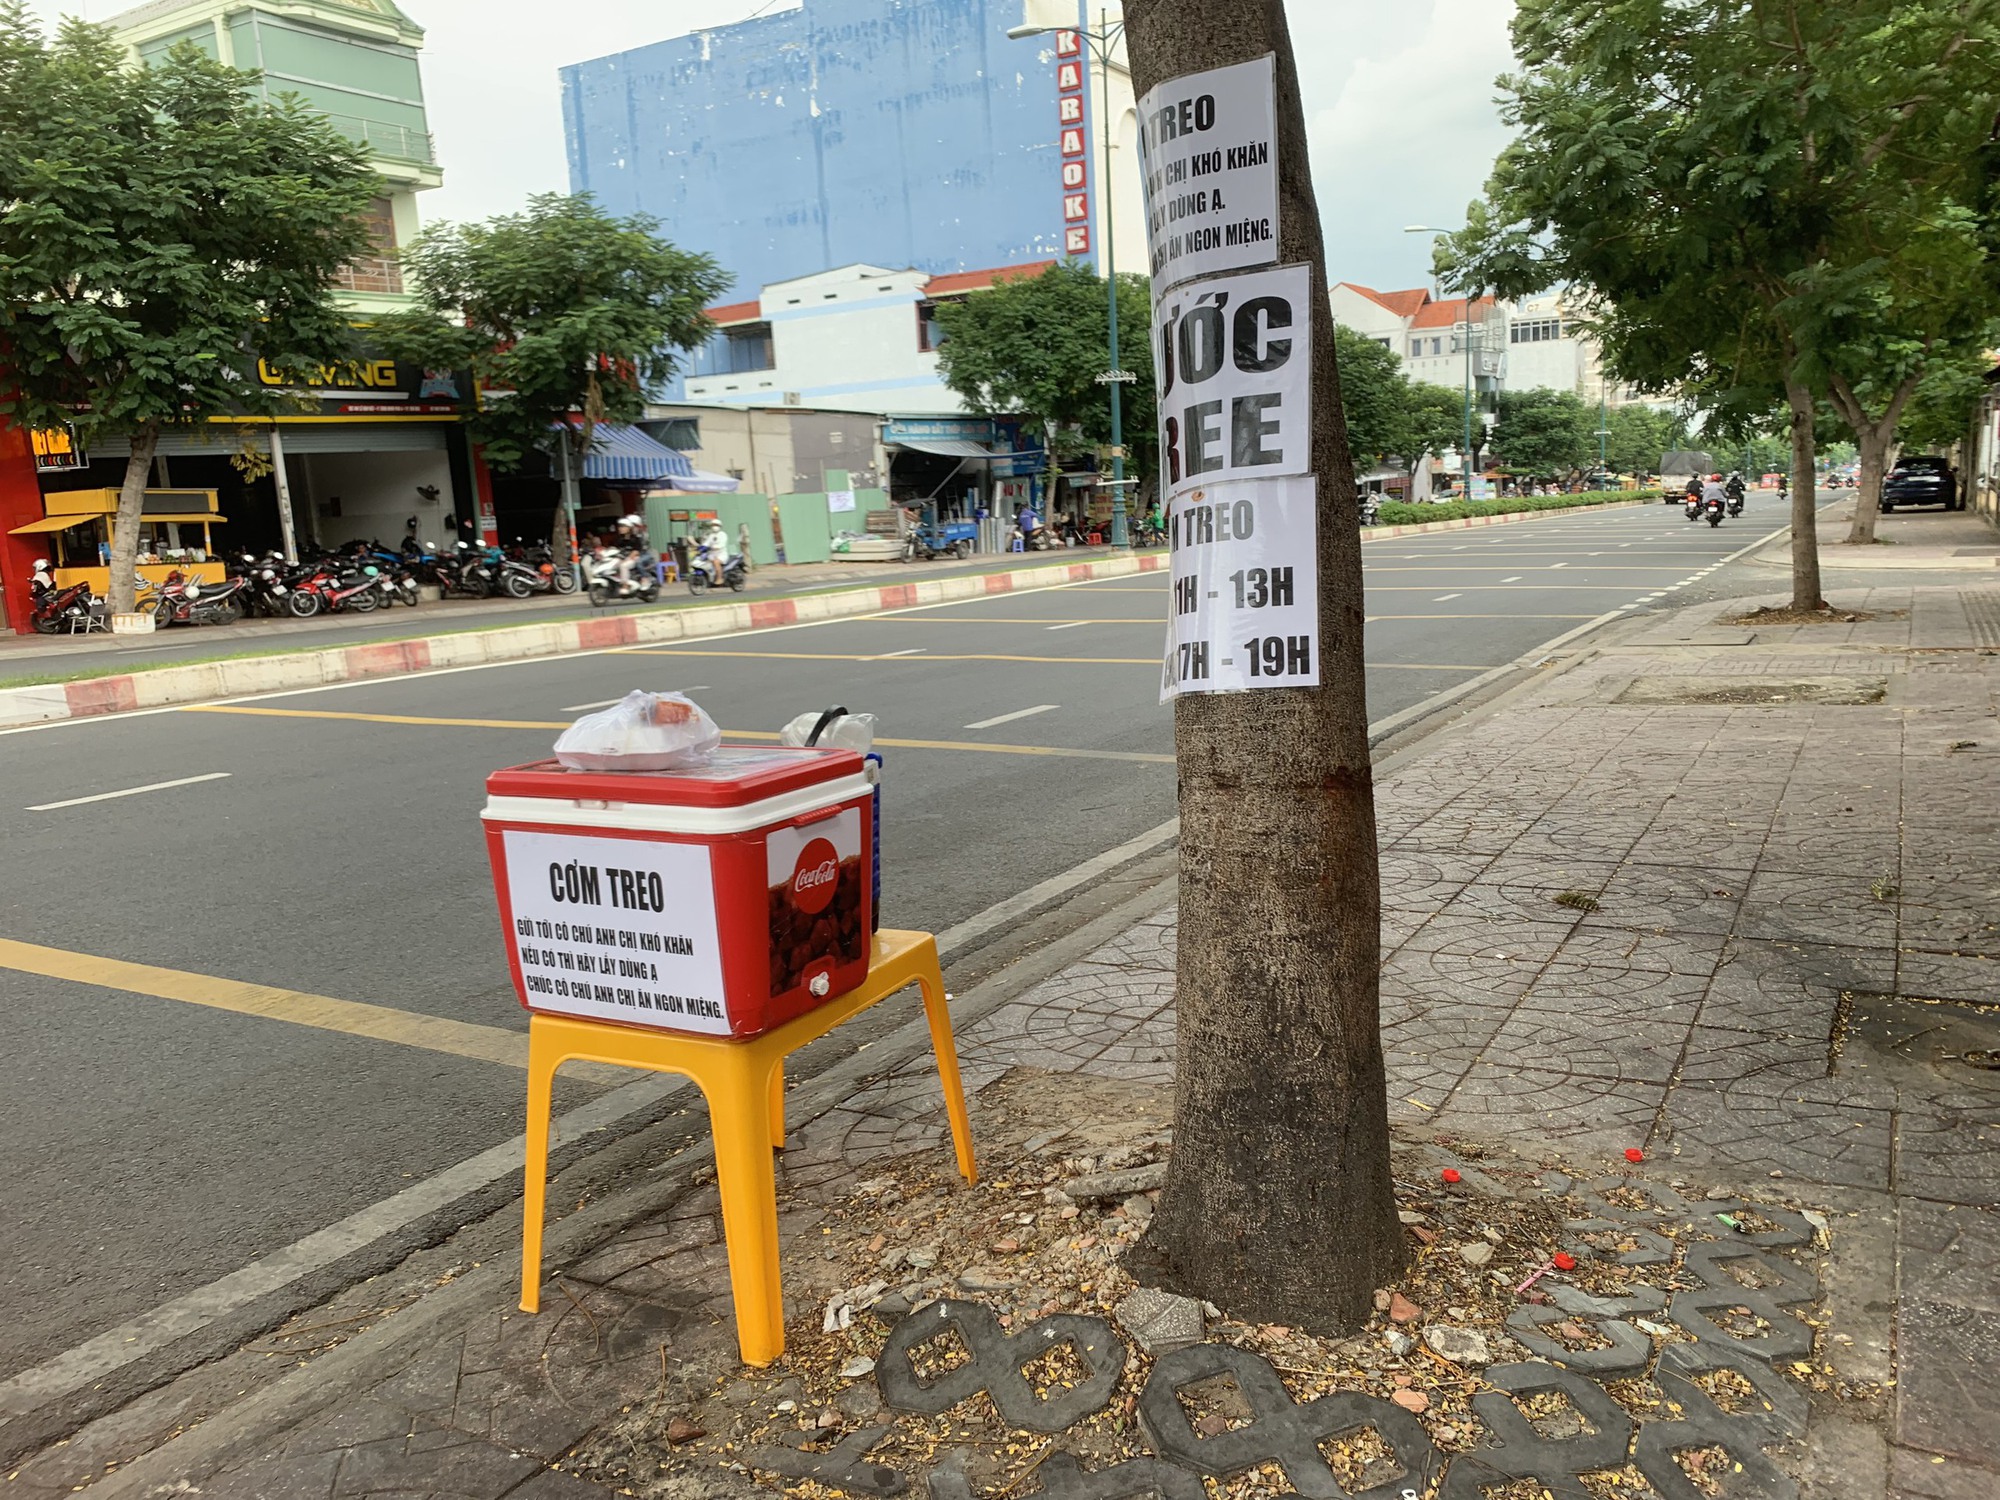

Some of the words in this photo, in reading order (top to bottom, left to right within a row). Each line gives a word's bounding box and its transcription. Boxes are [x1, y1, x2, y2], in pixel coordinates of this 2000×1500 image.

[1057, 30, 1087, 252] KARAOKE
[1149, 94, 1215, 150] TREO
[1166, 158, 1187, 185] CHỊ
[1192, 147, 1221, 177] KHÓ
[1227, 140, 1268, 170] KHĂN
[1169, 191, 1206, 223] DÙNG
[1185, 226, 1221, 254] NGON
[1226, 217, 1273, 248] MIỆNG.
[1184, 499, 1254, 547] TREO
[1229, 566, 1294, 609] 13H
[1244, 635, 1310, 677] 19H
[549, 858, 602, 905] CƠM
[605, 867, 664, 913] TREO
[555, 921, 569, 941] CÔ
[572, 924, 593, 944] CHÚ
[596, 927, 617, 947] ANH
[619, 930, 638, 952] CHỊ
[639, 932, 661, 953] KHÓ
[663, 935, 694, 956] KHĂN
[521, 942, 539, 965] NẾU
[541, 948, 556, 967] CÓ
[557, 951, 575, 970] THÌ
[619, 957, 648, 980] DÙNG
[650, 963, 659, 984] Ạ
[526, 974, 553, 994] CHÚC
[555, 978, 569, 997] CÔ
[571, 981, 592, 1000] CHÚ
[594, 985, 615, 1004] ANH
[617, 988, 636, 1010] CHỊ
[638, 988, 652, 1009] ĂN
[654, 993, 684, 1014] NGON
[686, 996, 725, 1020] MIỆNG.
